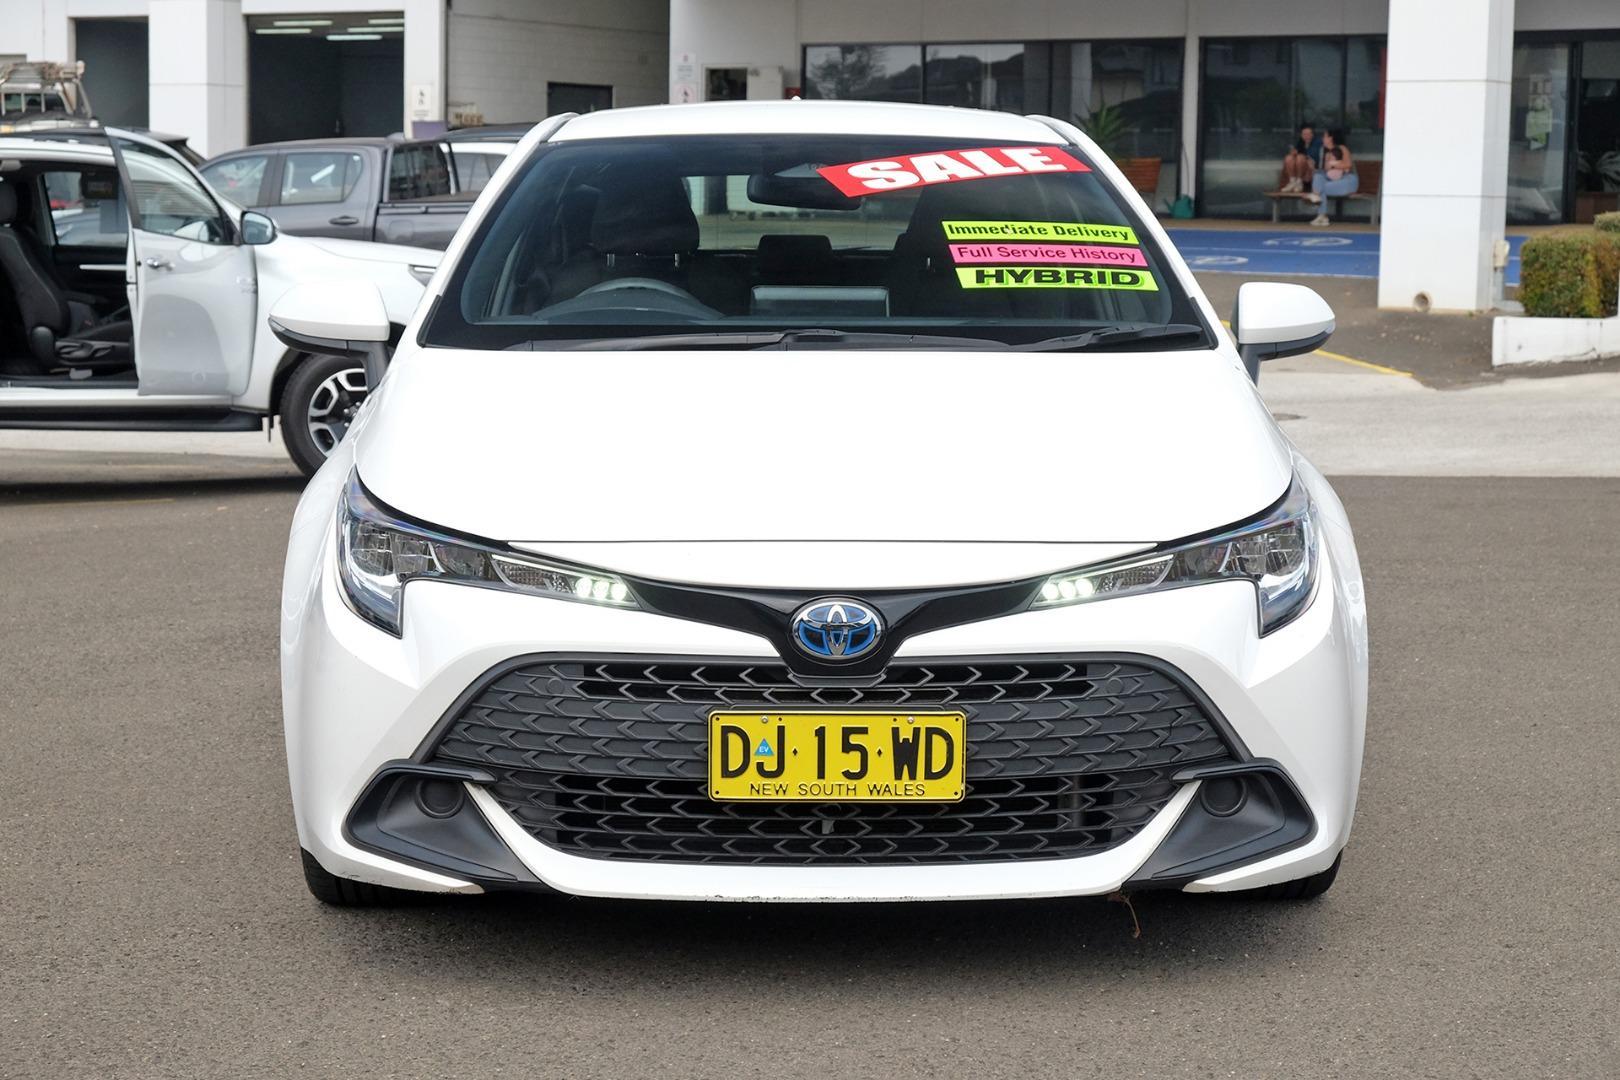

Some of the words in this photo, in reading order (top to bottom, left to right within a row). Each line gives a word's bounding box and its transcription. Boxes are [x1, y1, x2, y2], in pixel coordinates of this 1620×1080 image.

[847, 147, 1067, 190] SALE
[947, 224, 1048, 236] Immediate
[1053, 225, 1129, 241] Delivery
[957, 246, 993, 258] Full
[996, 246, 1066, 259] Service
[1070, 247, 1136, 263] History
[975, 269, 1142, 286] HYBRID
[750, 783, 788, 796] NEW
[799, 783, 857, 796] SOUTH
[867, 783, 925, 796] WALES
